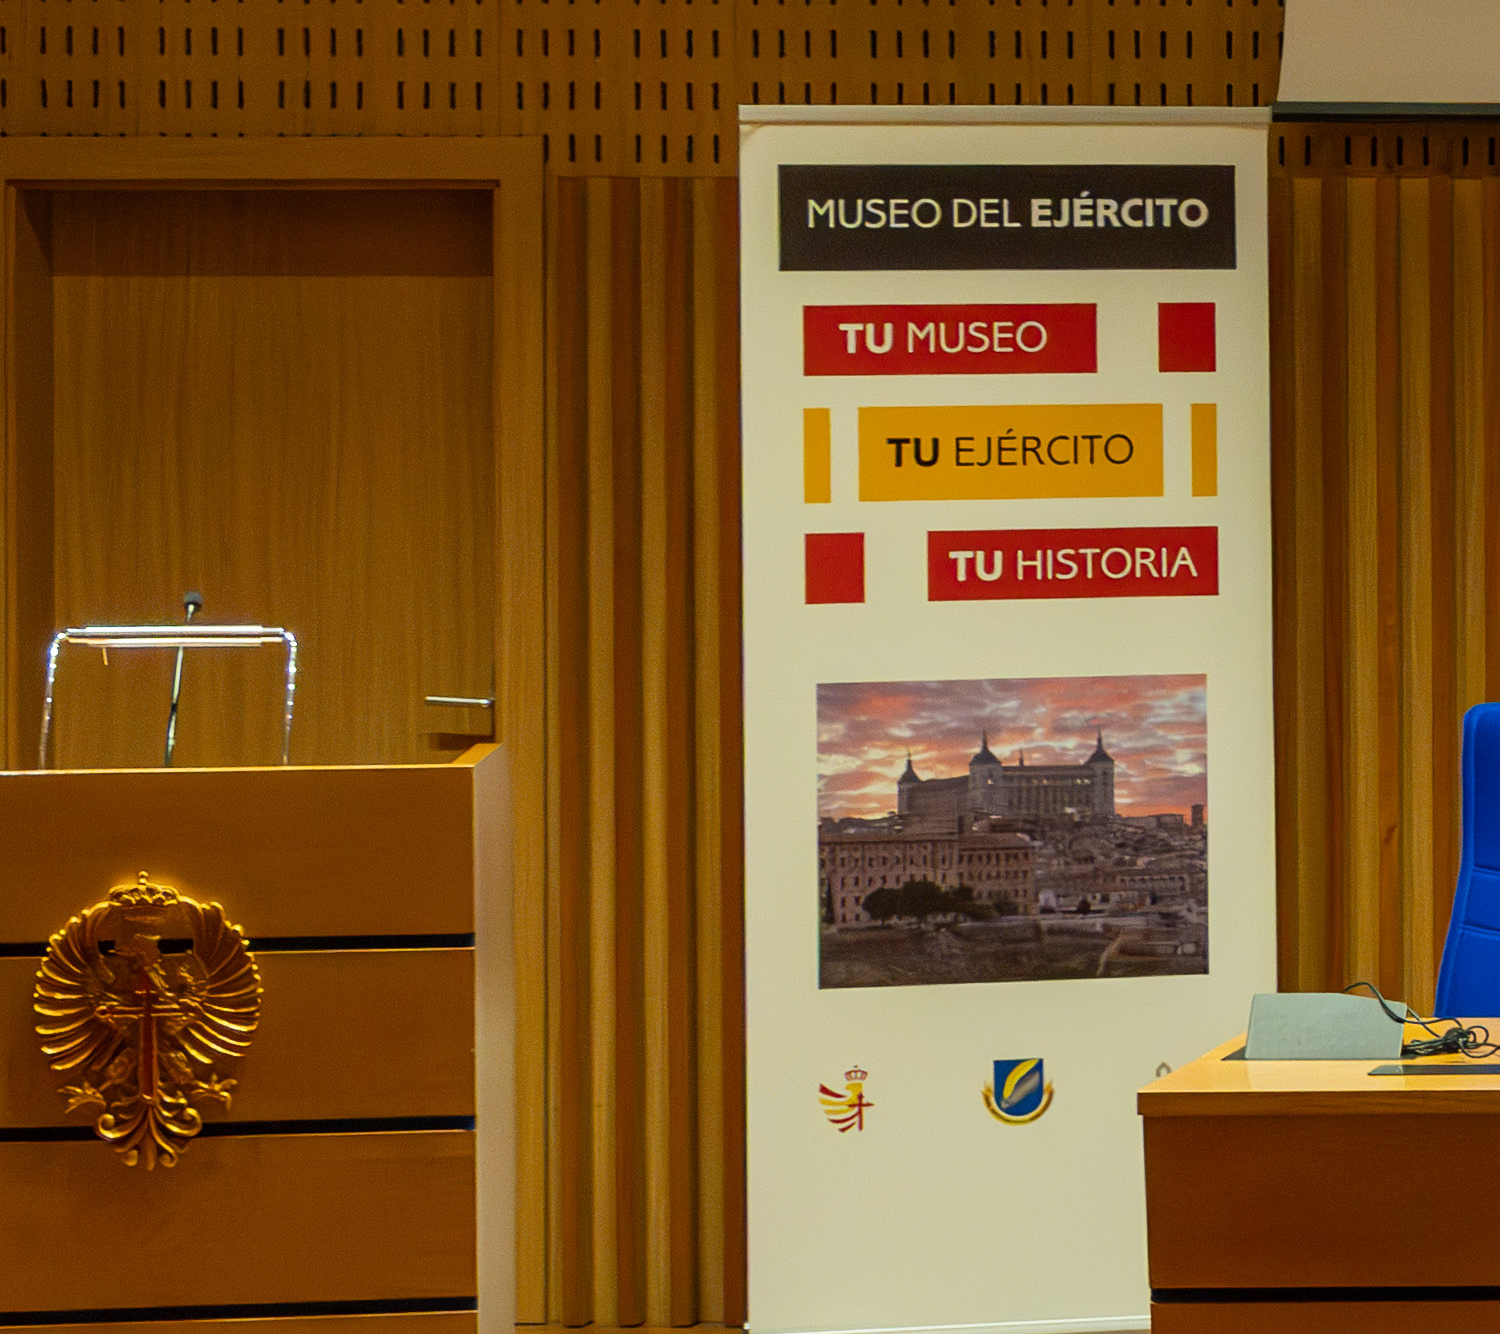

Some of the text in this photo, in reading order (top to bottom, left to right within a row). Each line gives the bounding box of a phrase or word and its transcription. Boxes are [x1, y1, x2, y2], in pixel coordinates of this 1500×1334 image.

[806, 191, 1209, 229] MUSEO DEL EJÉRCITO
[839, 320, 1047, 354] TU MUSEO
[886, 429, 1134, 468] TU EJÉRCITO
[948, 546, 1198, 582] TU HISTORIA
